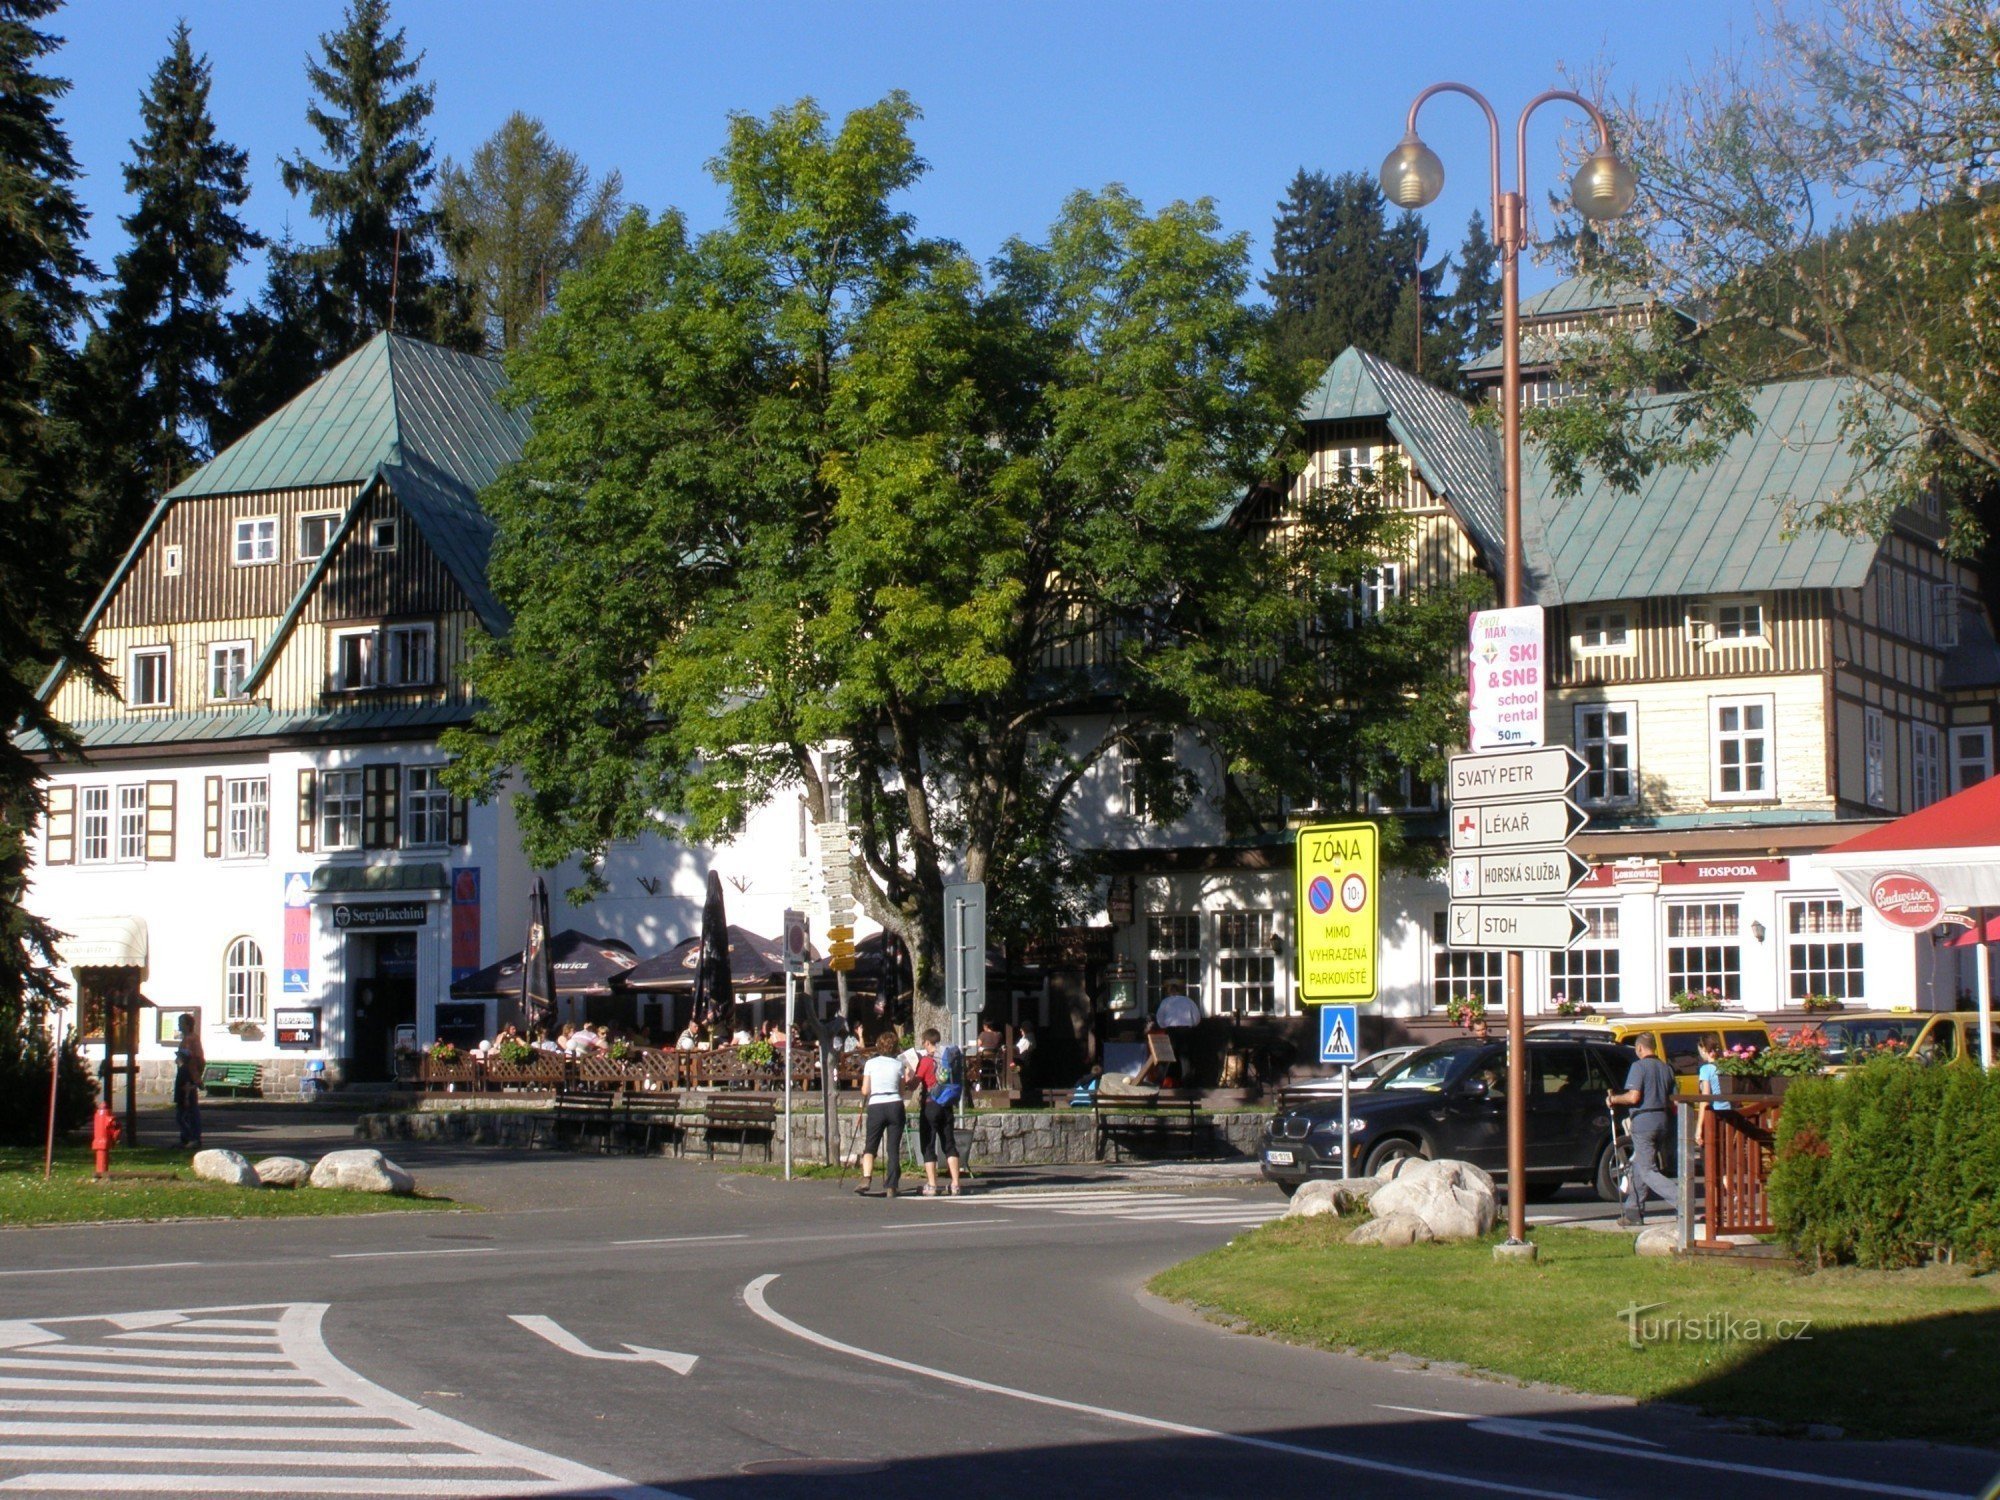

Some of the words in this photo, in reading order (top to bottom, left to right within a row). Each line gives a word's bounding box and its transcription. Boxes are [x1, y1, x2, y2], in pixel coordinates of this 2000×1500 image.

[1485, 626, 1507, 639] MAX
[1509, 643, 1537, 662] SKI
[1498, 690, 1538, 706] school
[1498, 707, 1538, 723] rental
[1497, 730, 1521, 741] 50m
[1458, 765, 1497, 787] SVATÝ
[1500, 765, 1533, 783] PETR
[1485, 812, 1530, 834] LÉKAŘ
[1312, 834, 1362, 863] ZÓNA
[1484, 863, 1521, 884] HORSKÁ
[1524, 862, 1561, 881] SLUŽBA
[1698, 865, 1758, 877] HOSPODA
[1325, 925, 1350, 938] MIMO
[1484, 917, 1517, 933] STOH
[1309, 947, 1367, 962] VYHRAZENÁ
[1309, 968, 1367, 985] PARKOVIŠTĚ
